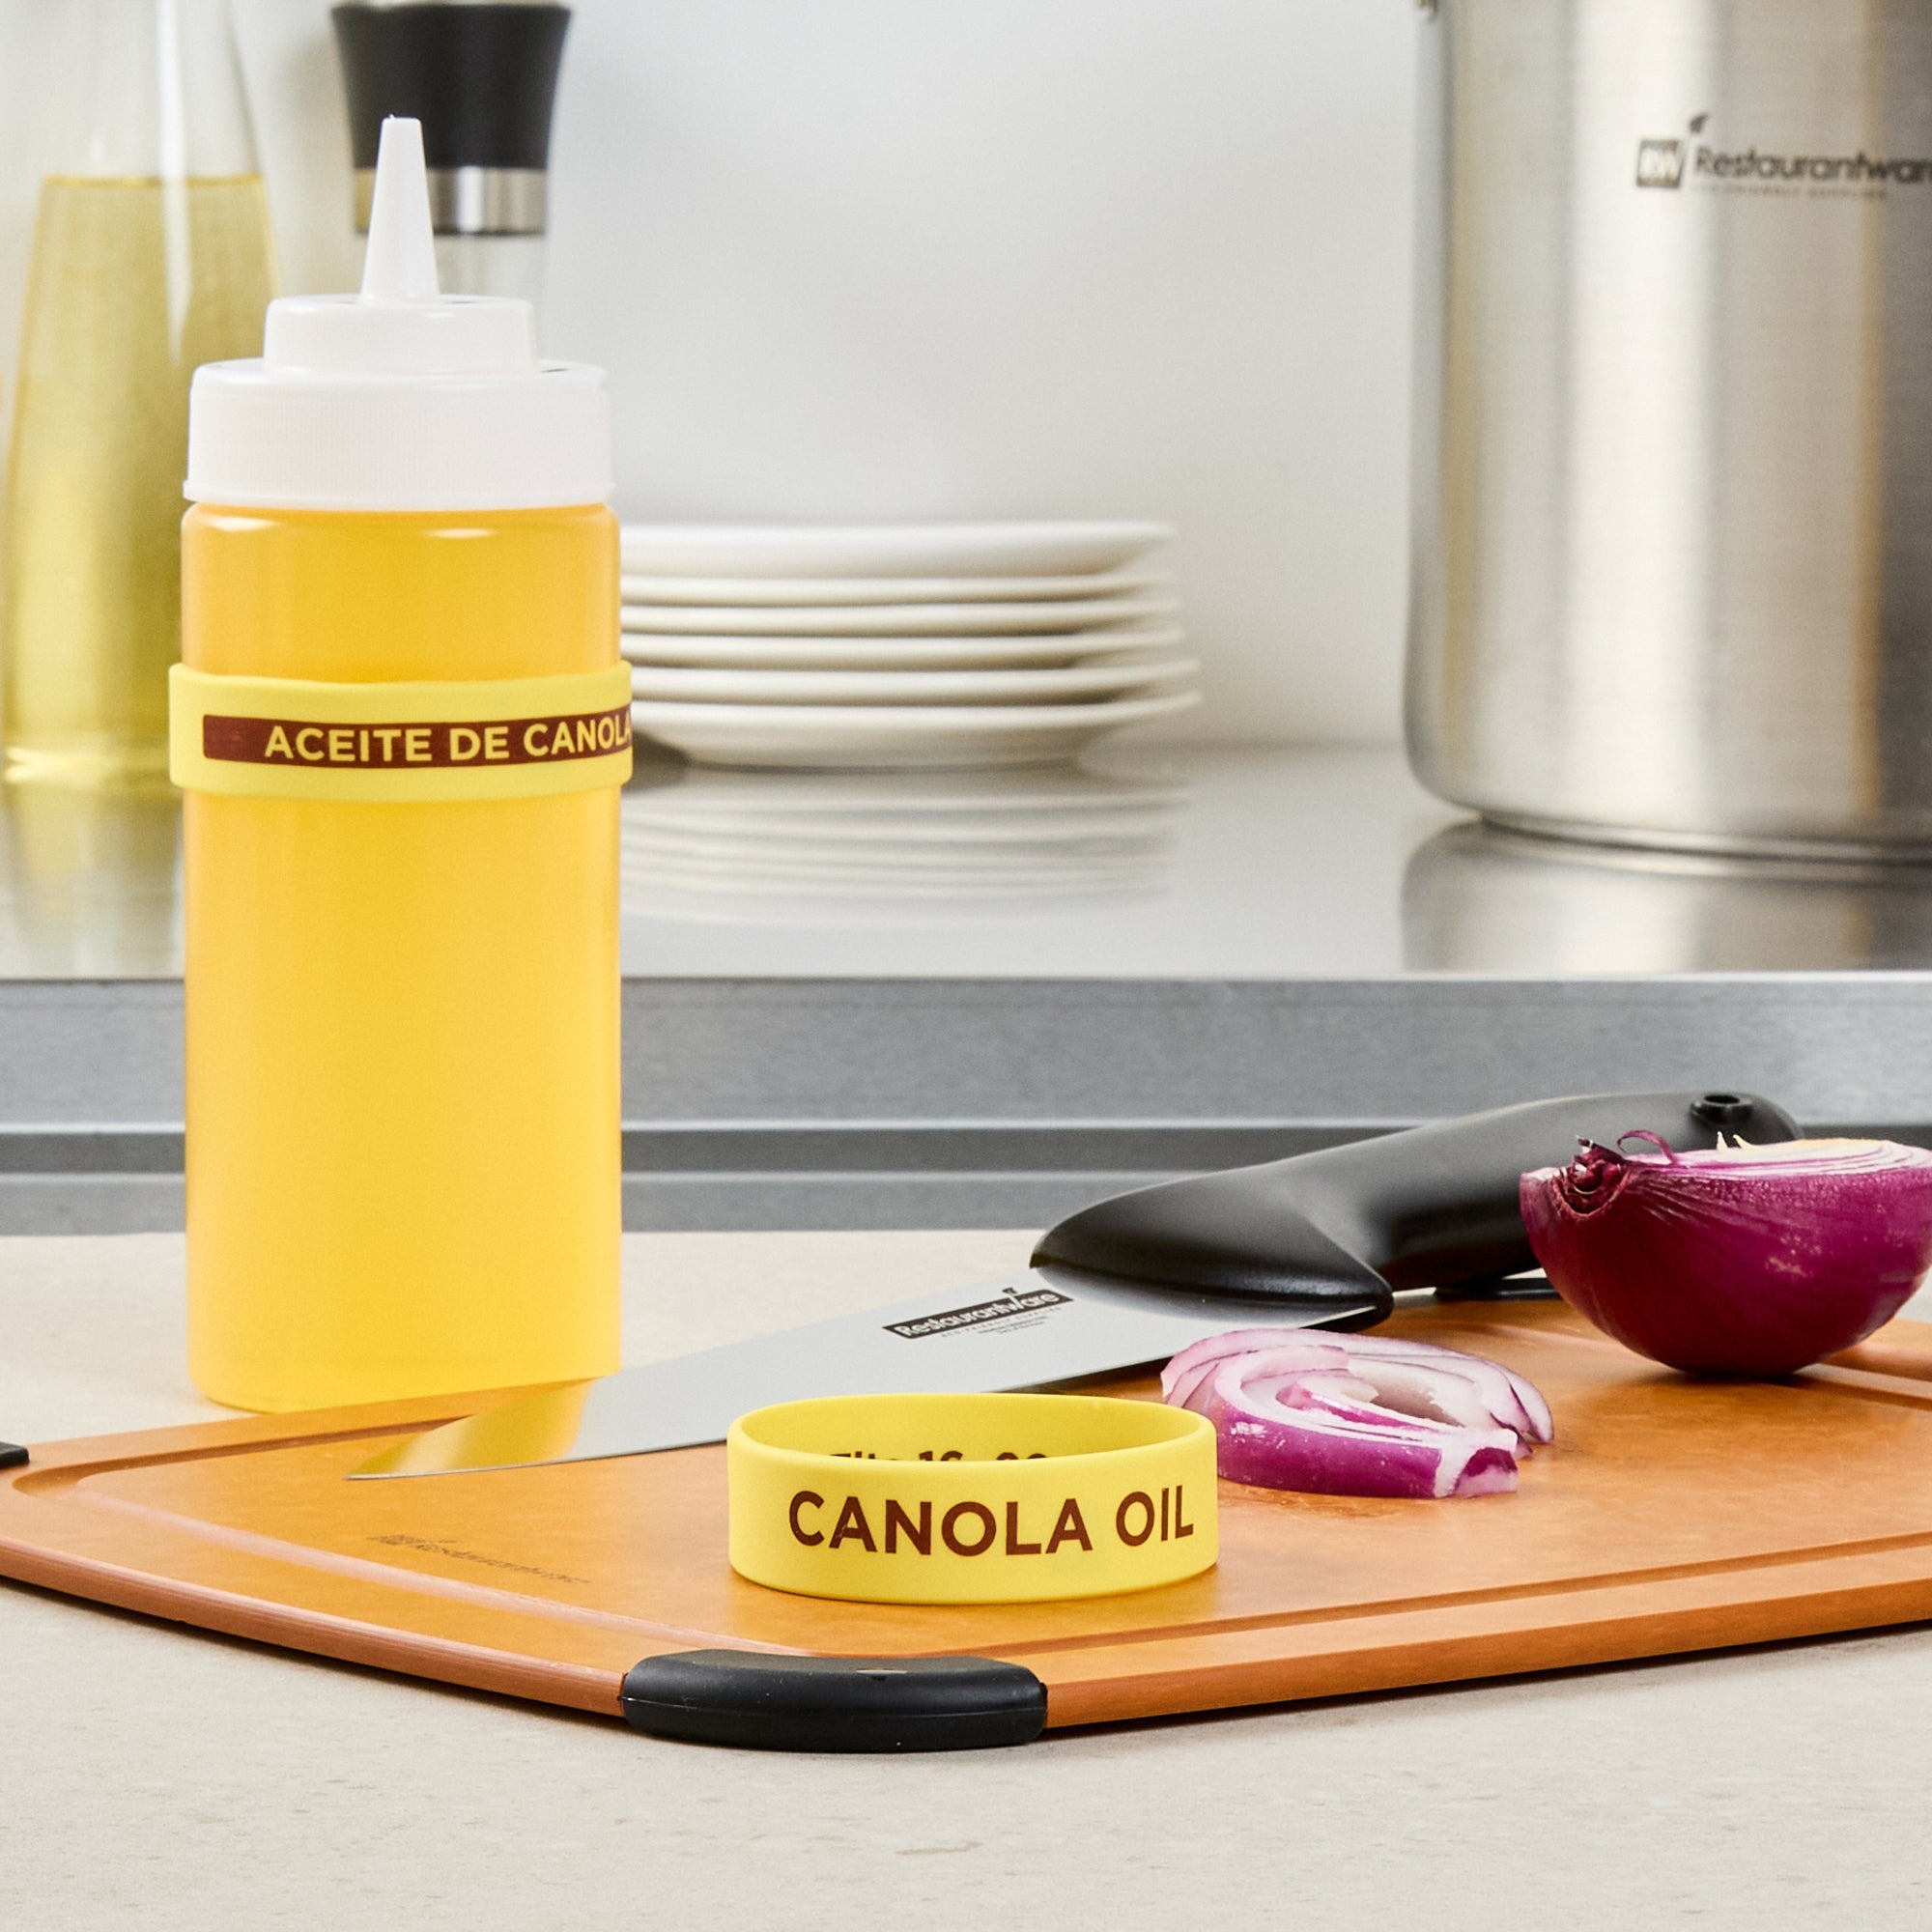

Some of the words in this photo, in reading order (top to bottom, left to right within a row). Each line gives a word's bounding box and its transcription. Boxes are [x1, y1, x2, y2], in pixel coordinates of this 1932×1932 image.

[1695, 147, 1932, 185] Restaurantwar
[264, 724, 433, 762] ACEITE
[449, 725, 510, 761] DE
[788, 1490, 1094, 1557] CANOLA
[1116, 1484, 1195, 1548] OIL
